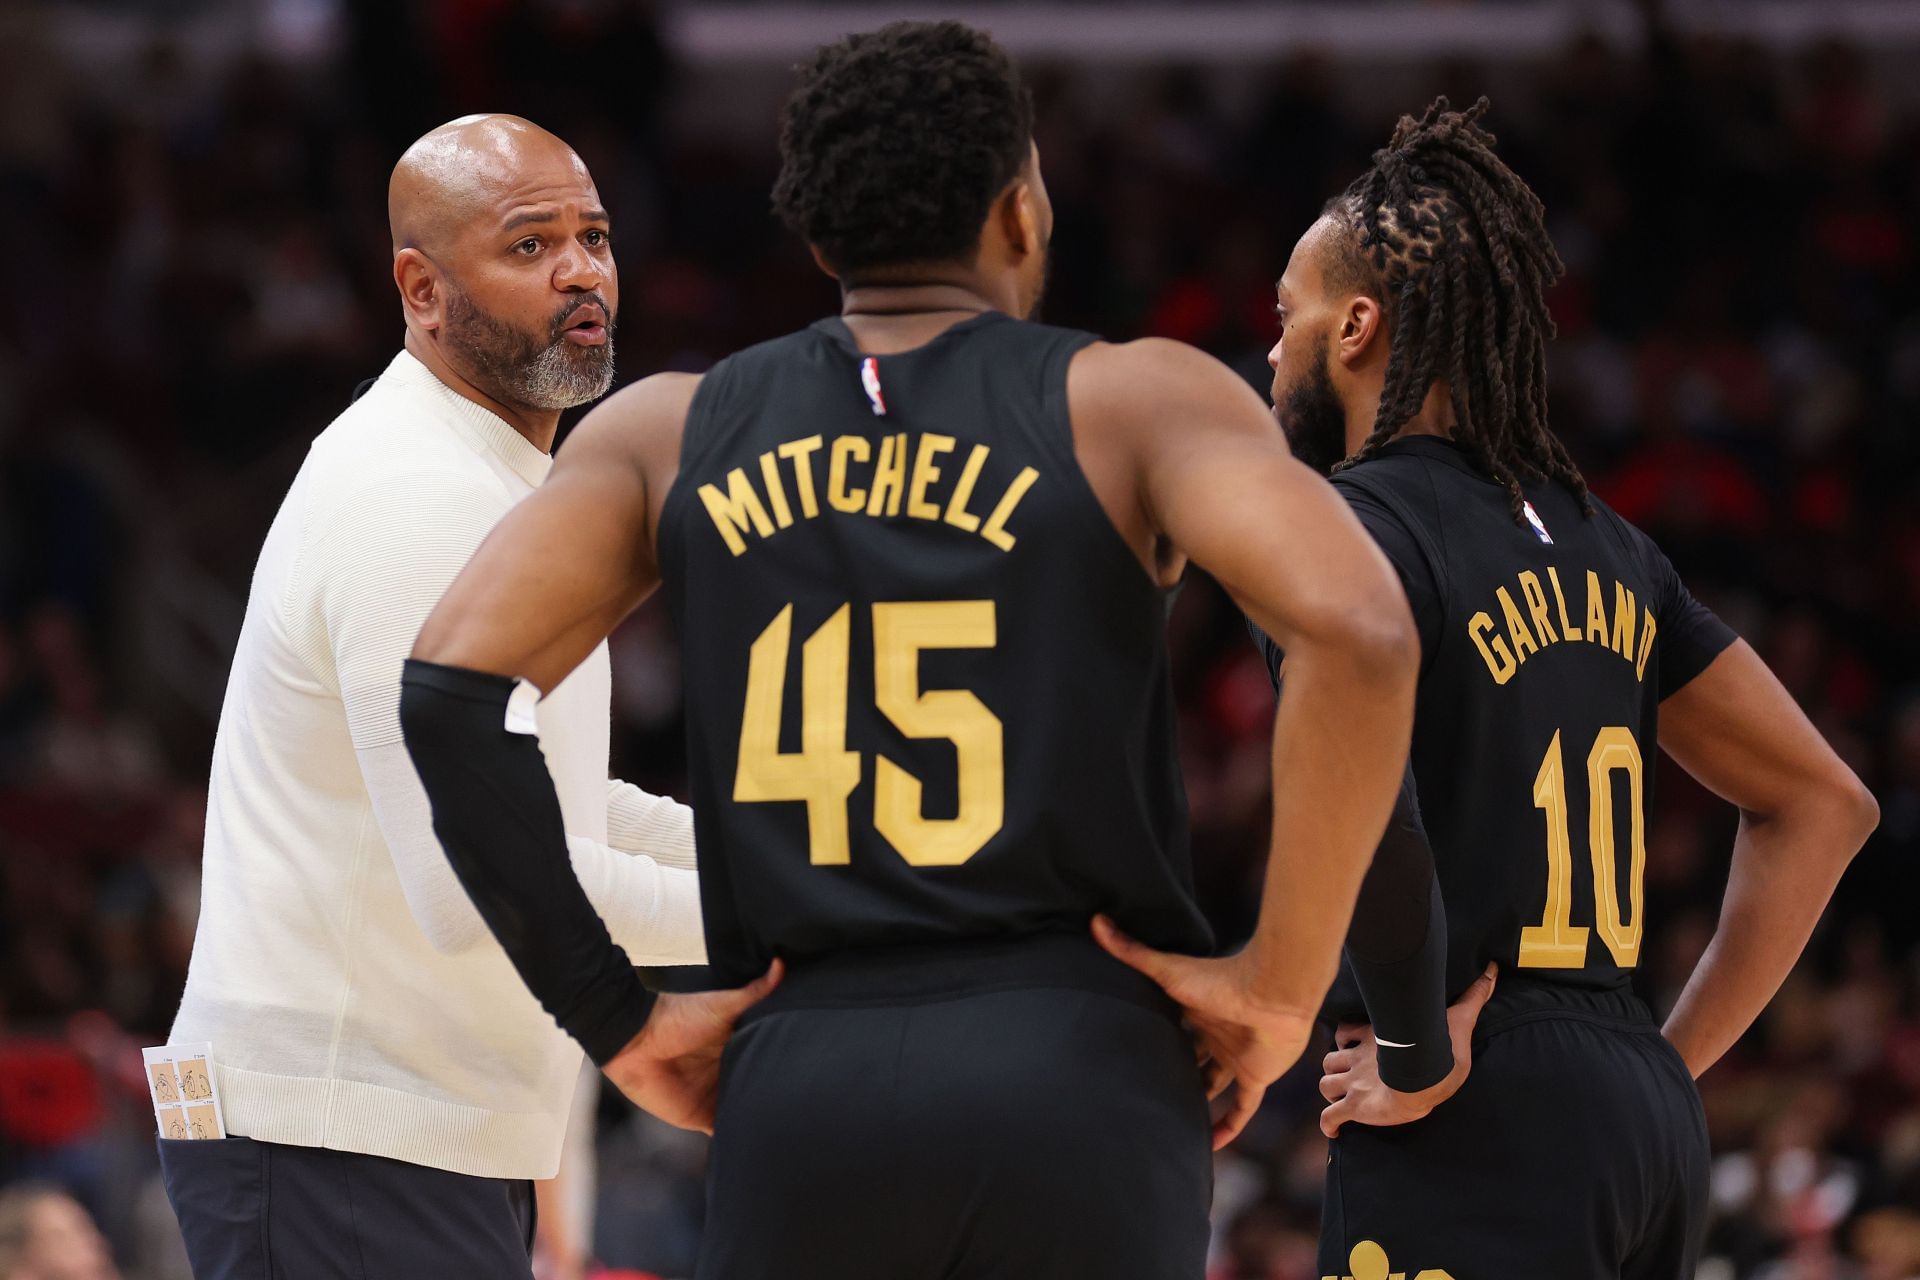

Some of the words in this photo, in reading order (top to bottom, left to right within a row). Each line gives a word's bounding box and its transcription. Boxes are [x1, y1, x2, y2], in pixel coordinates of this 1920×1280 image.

[697, 432, 1040, 557] MITCHELL
[1467, 566, 1657, 685] GARLAND
[732, 599, 1005, 867] 45
[1517, 726, 1647, 969] 10
